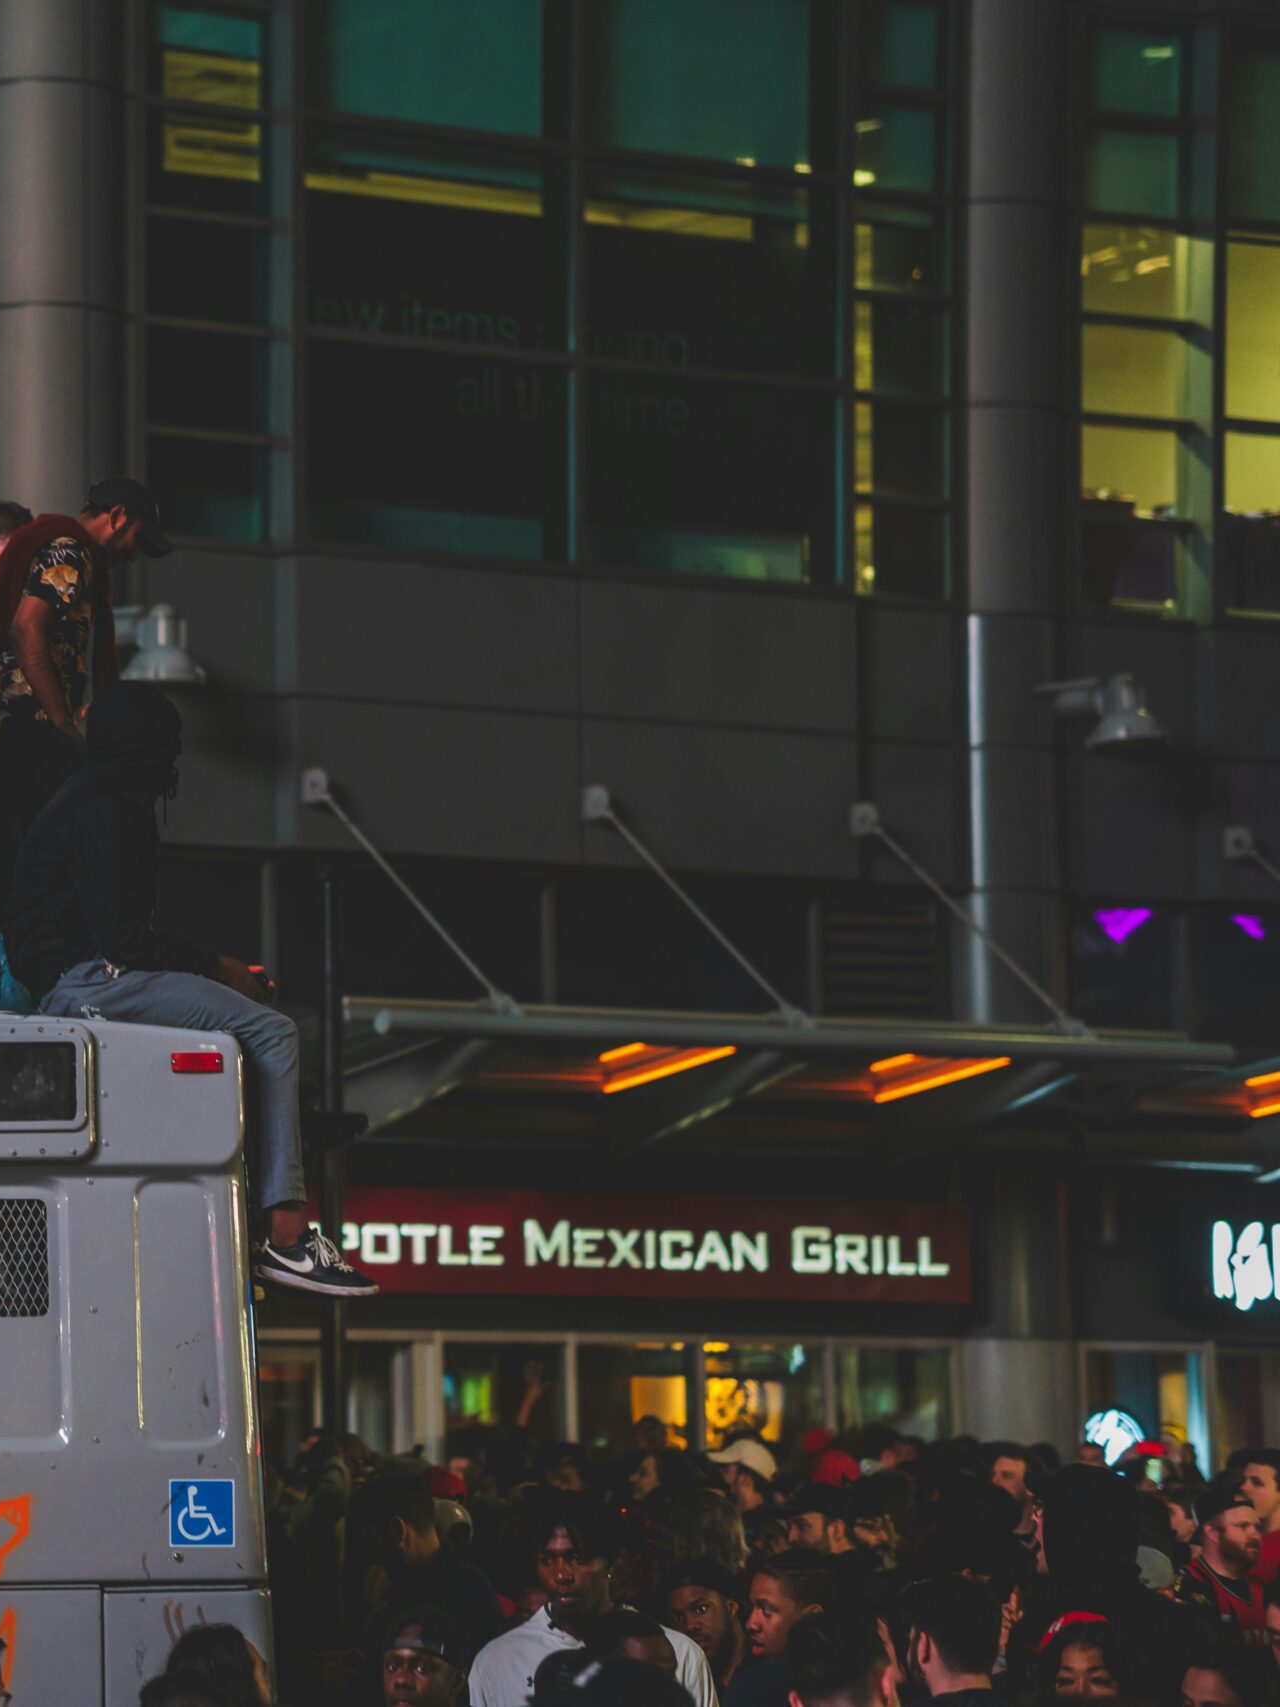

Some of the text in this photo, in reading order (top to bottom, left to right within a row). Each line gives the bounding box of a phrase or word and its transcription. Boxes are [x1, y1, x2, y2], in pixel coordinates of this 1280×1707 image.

[308, 1218, 951, 1277] POTLE MEXICAN GRILL
